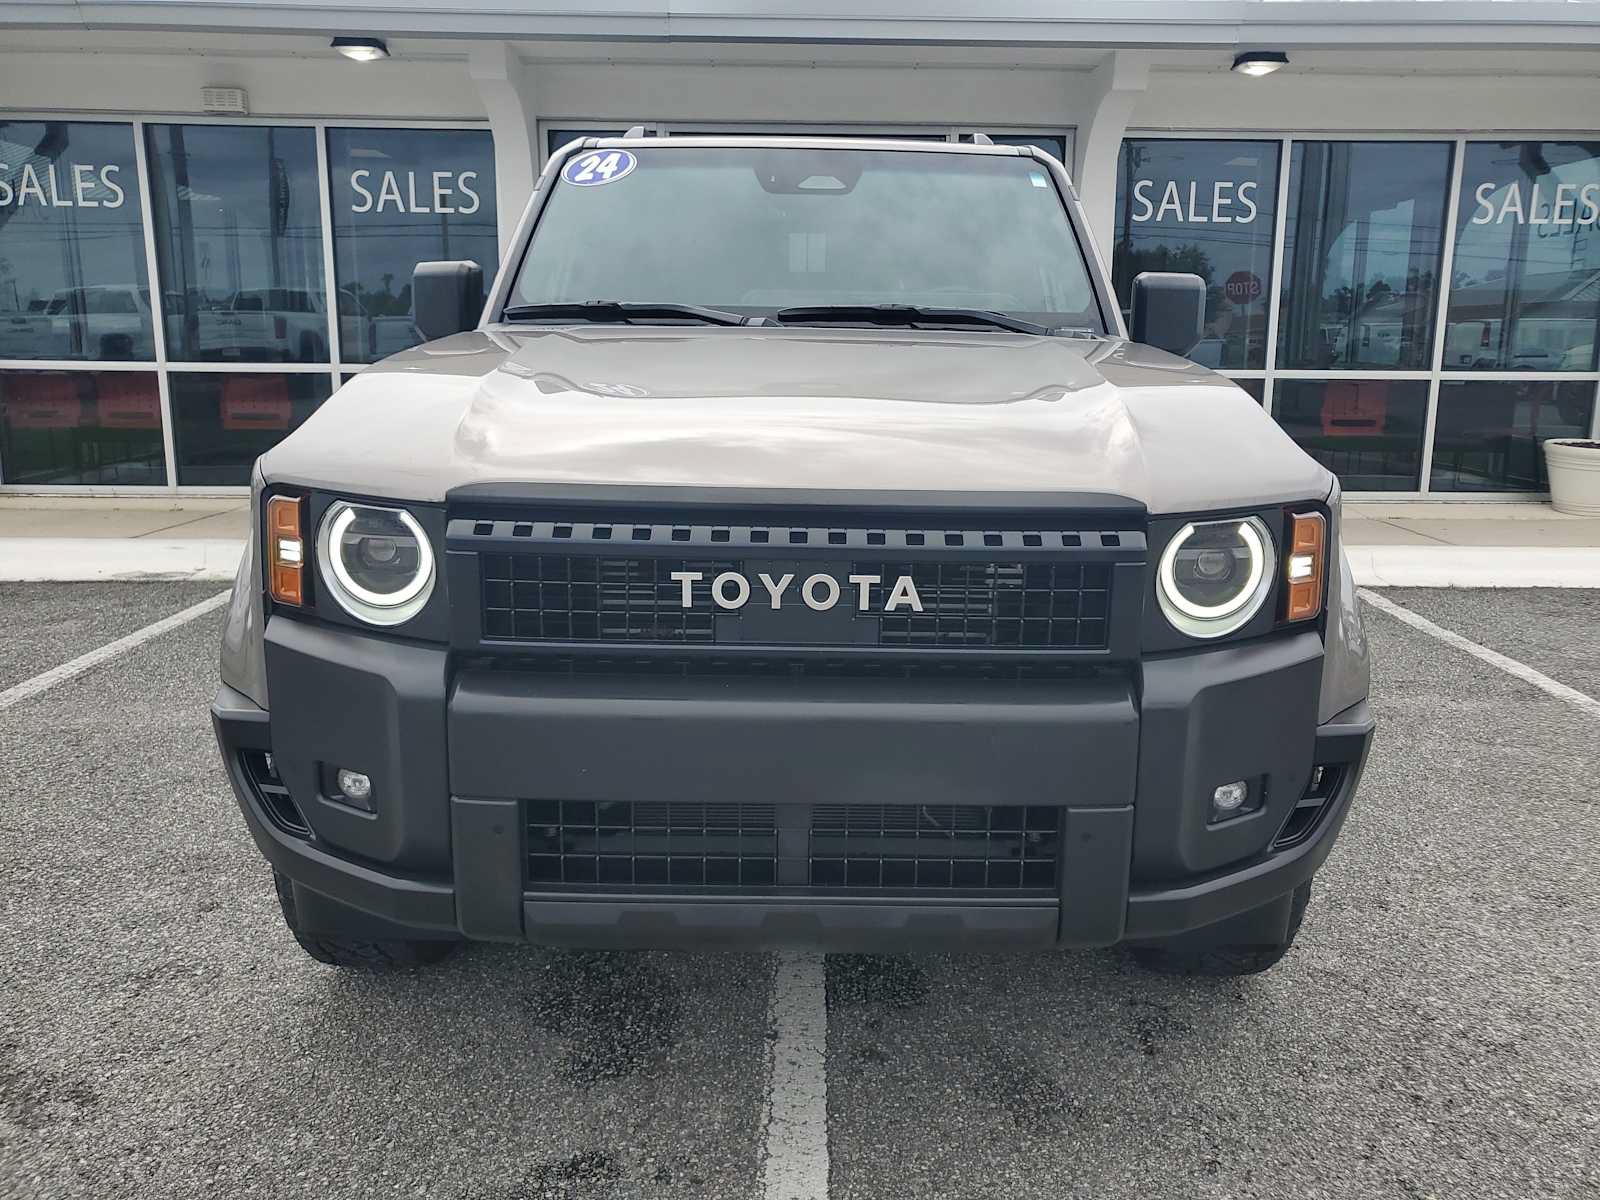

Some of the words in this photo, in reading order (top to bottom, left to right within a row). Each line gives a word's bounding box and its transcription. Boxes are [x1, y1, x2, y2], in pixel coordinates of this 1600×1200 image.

[574, 153, 622, 181] 24
[350, 169, 480, 214] SALES
[1131, 180, 1257, 223] SALES
[1471, 182, 1600, 225] SALES
[670, 571, 924, 612] TOYOTA
